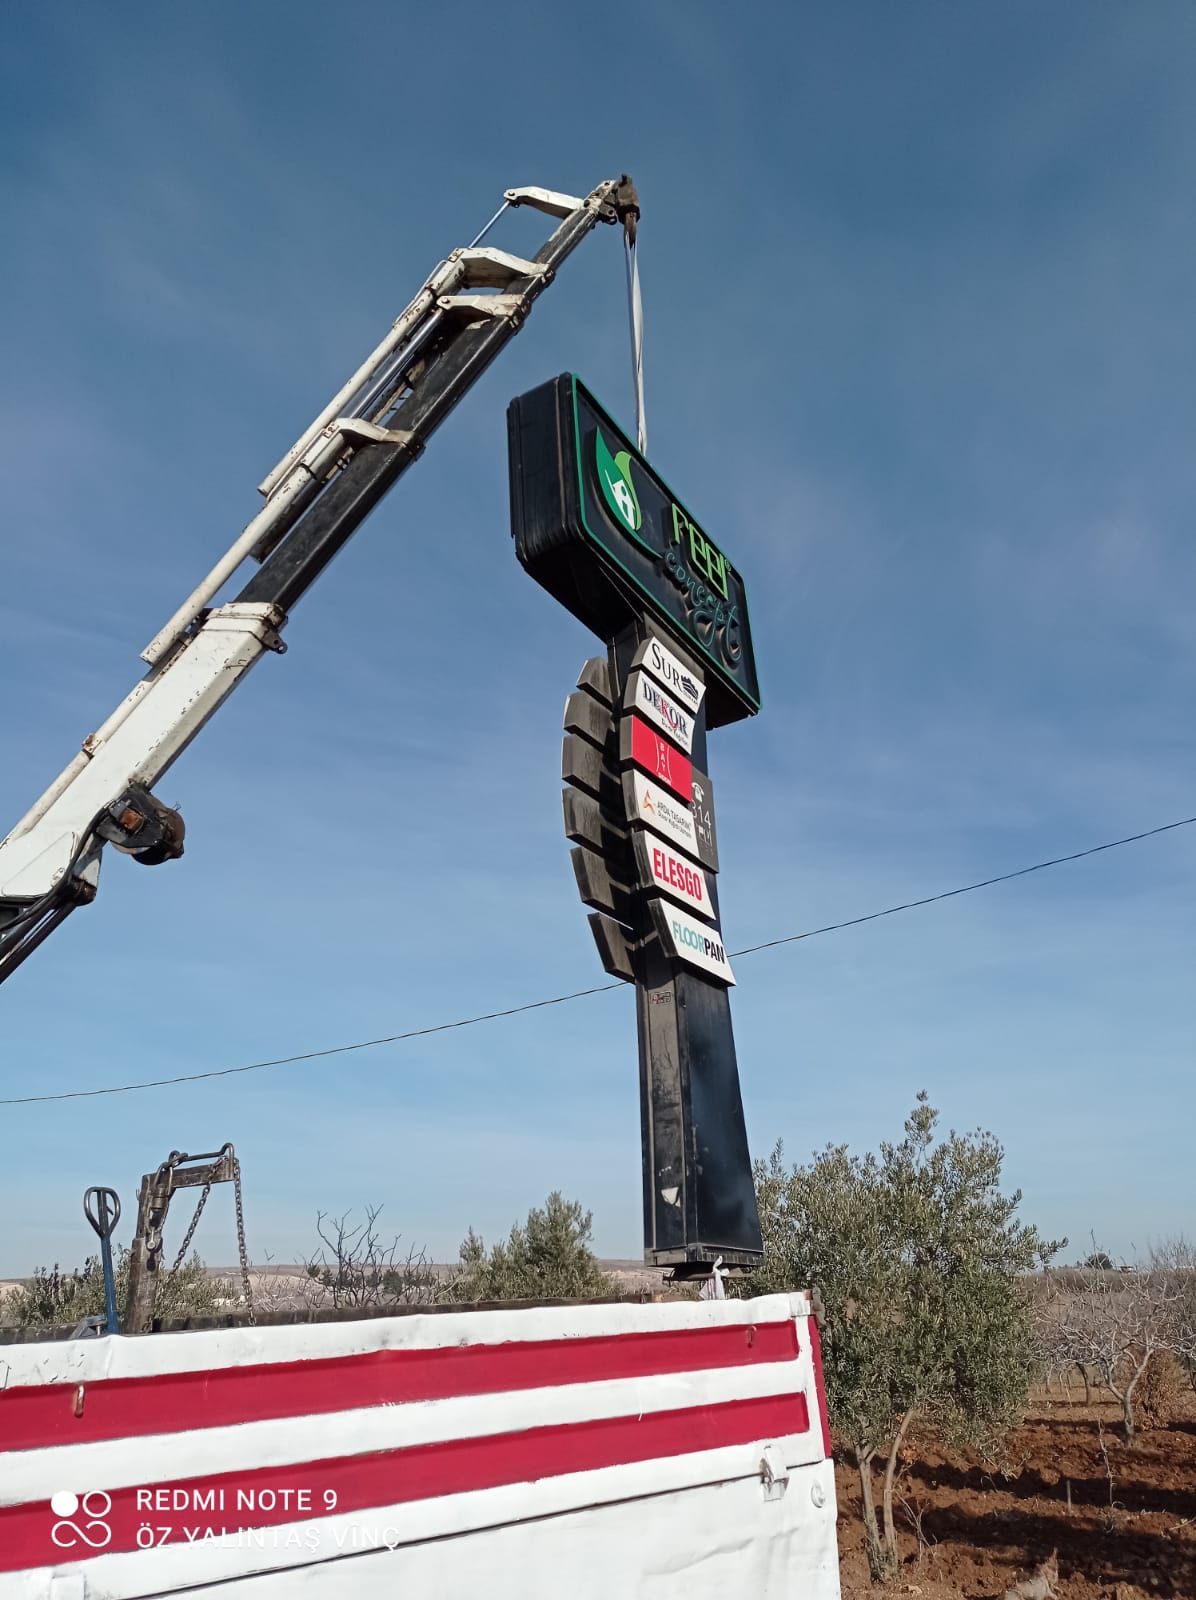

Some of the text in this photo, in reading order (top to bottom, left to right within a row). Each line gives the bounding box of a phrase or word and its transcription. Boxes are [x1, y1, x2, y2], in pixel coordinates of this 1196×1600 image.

[642, 678, 688, 738] DEKOR
[653, 848, 702, 901] ELESGO
[673, 920, 725, 964] FLOORPAN
